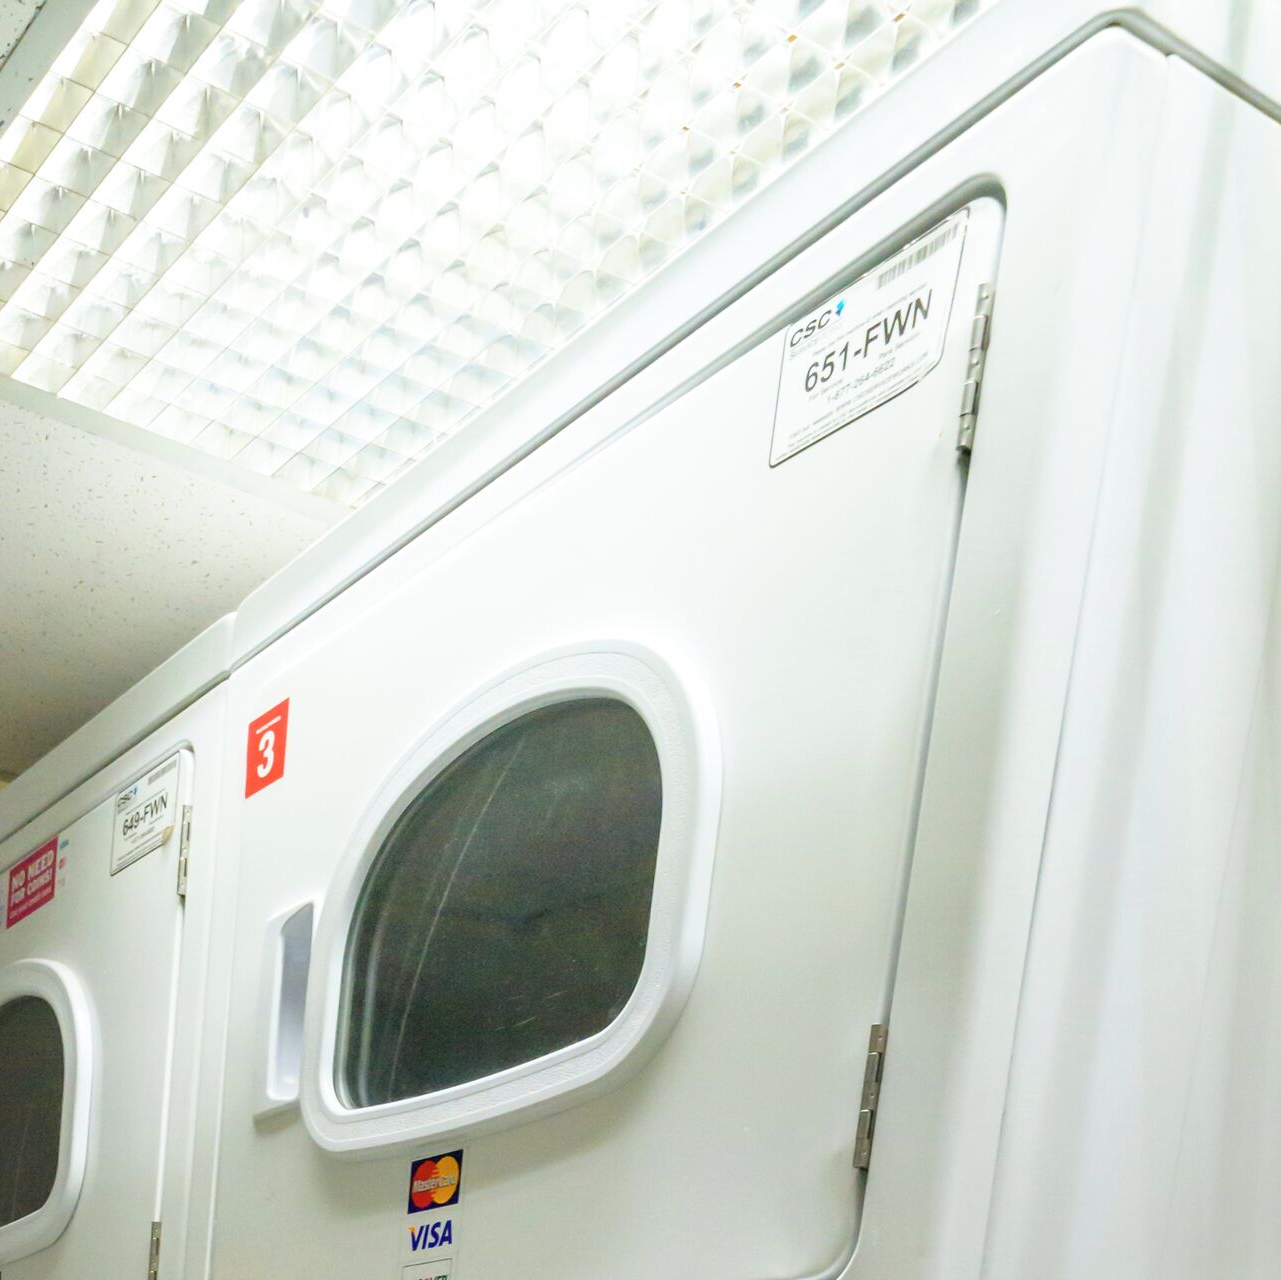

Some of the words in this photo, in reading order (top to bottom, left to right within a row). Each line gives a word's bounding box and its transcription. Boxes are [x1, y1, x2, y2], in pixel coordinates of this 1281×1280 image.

[790, 309, 831, 348] CSC
[804, 288, 933, 393] 651-FWN
[257, 730, 275, 778] 3
[122, 792, 168, 836] 649-FWN
[12, 870, 25, 892] NO
[27, 850, 54, 880] NEED
[409, 1219, 453, 1251] VISA
